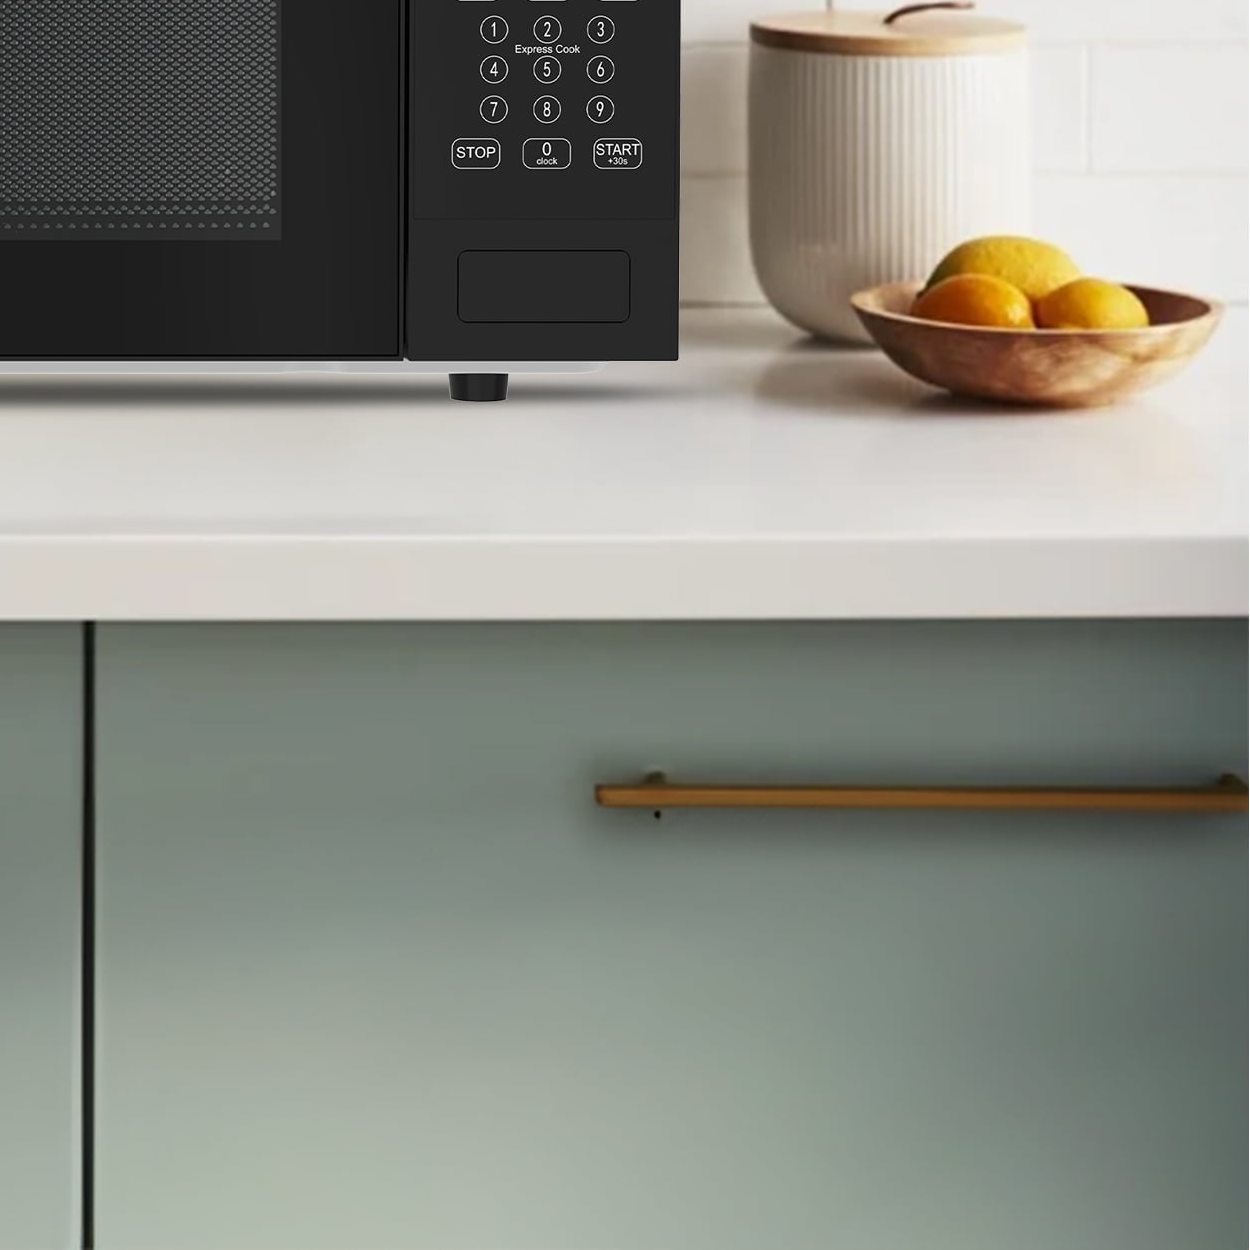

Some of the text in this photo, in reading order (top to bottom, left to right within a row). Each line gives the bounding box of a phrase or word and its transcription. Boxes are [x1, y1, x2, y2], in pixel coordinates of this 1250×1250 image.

[490, 21, 497, 38] 1
[543, 21, 552, 38] 2
[596, 21, 605, 38] 3
[515, 45, 580, 55] Express Cook
[489, 61, 499, 78] 4
[542, 61, 552, 78] 5
[596, 61, 605, 78] 6
[489, 101, 499, 118] 7
[542, 101, 552, 118] 8
[595, 100, 605, 118] 9
[456, 146, 496, 158] STOP
[541, 141, 552, 156] 0
[595, 142, 640, 156] START
[536, 157, 557, 165] clock
[608, 157, 628, 165] +30s
